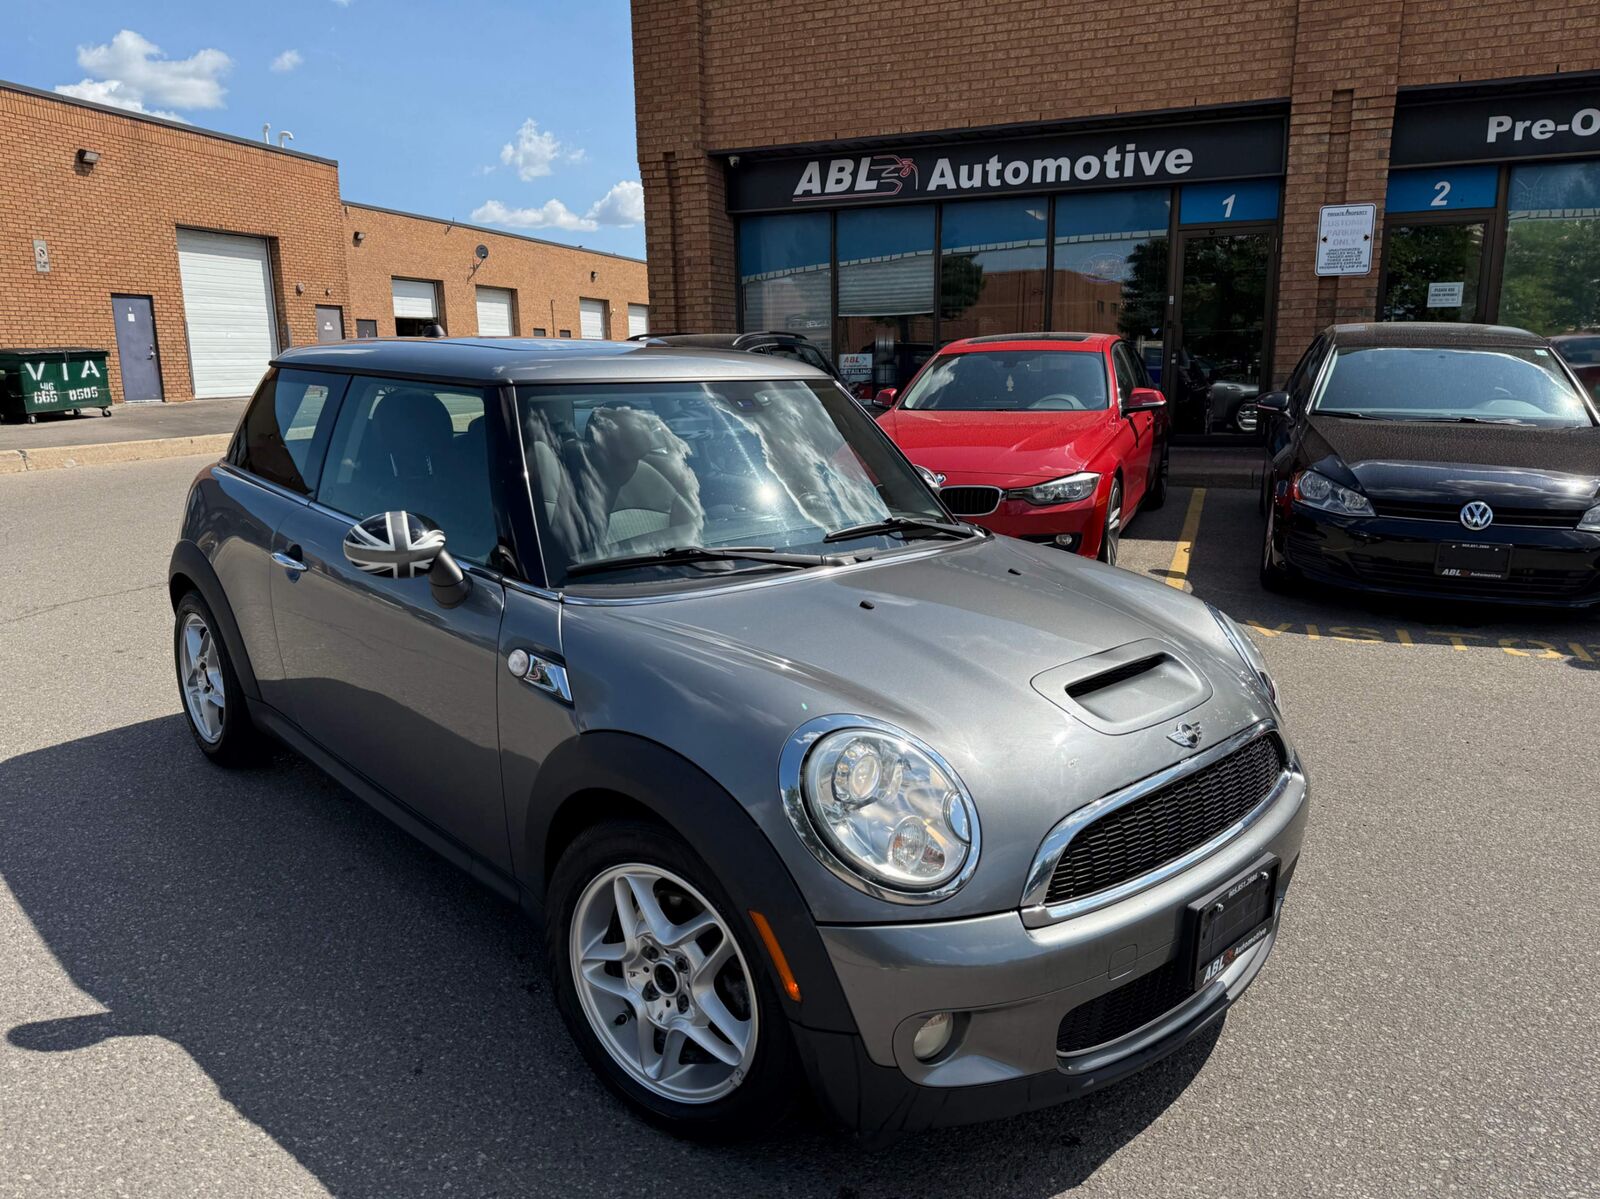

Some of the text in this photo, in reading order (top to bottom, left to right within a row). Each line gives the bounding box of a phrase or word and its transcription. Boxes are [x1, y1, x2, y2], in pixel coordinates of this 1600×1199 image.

[793, 143, 1194, 196] ABL Automotive
[1430, 181, 1451, 206] 2
[1222, 193, 1236, 218] 1
[24, 360, 101, 381] VIA
[34, 386, 99, 404] 665 0505
[40, 382, 54, 391] 416
[1441, 568, 1461, 577] ABL
[1202, 927, 1267, 984] ABL Automotive
